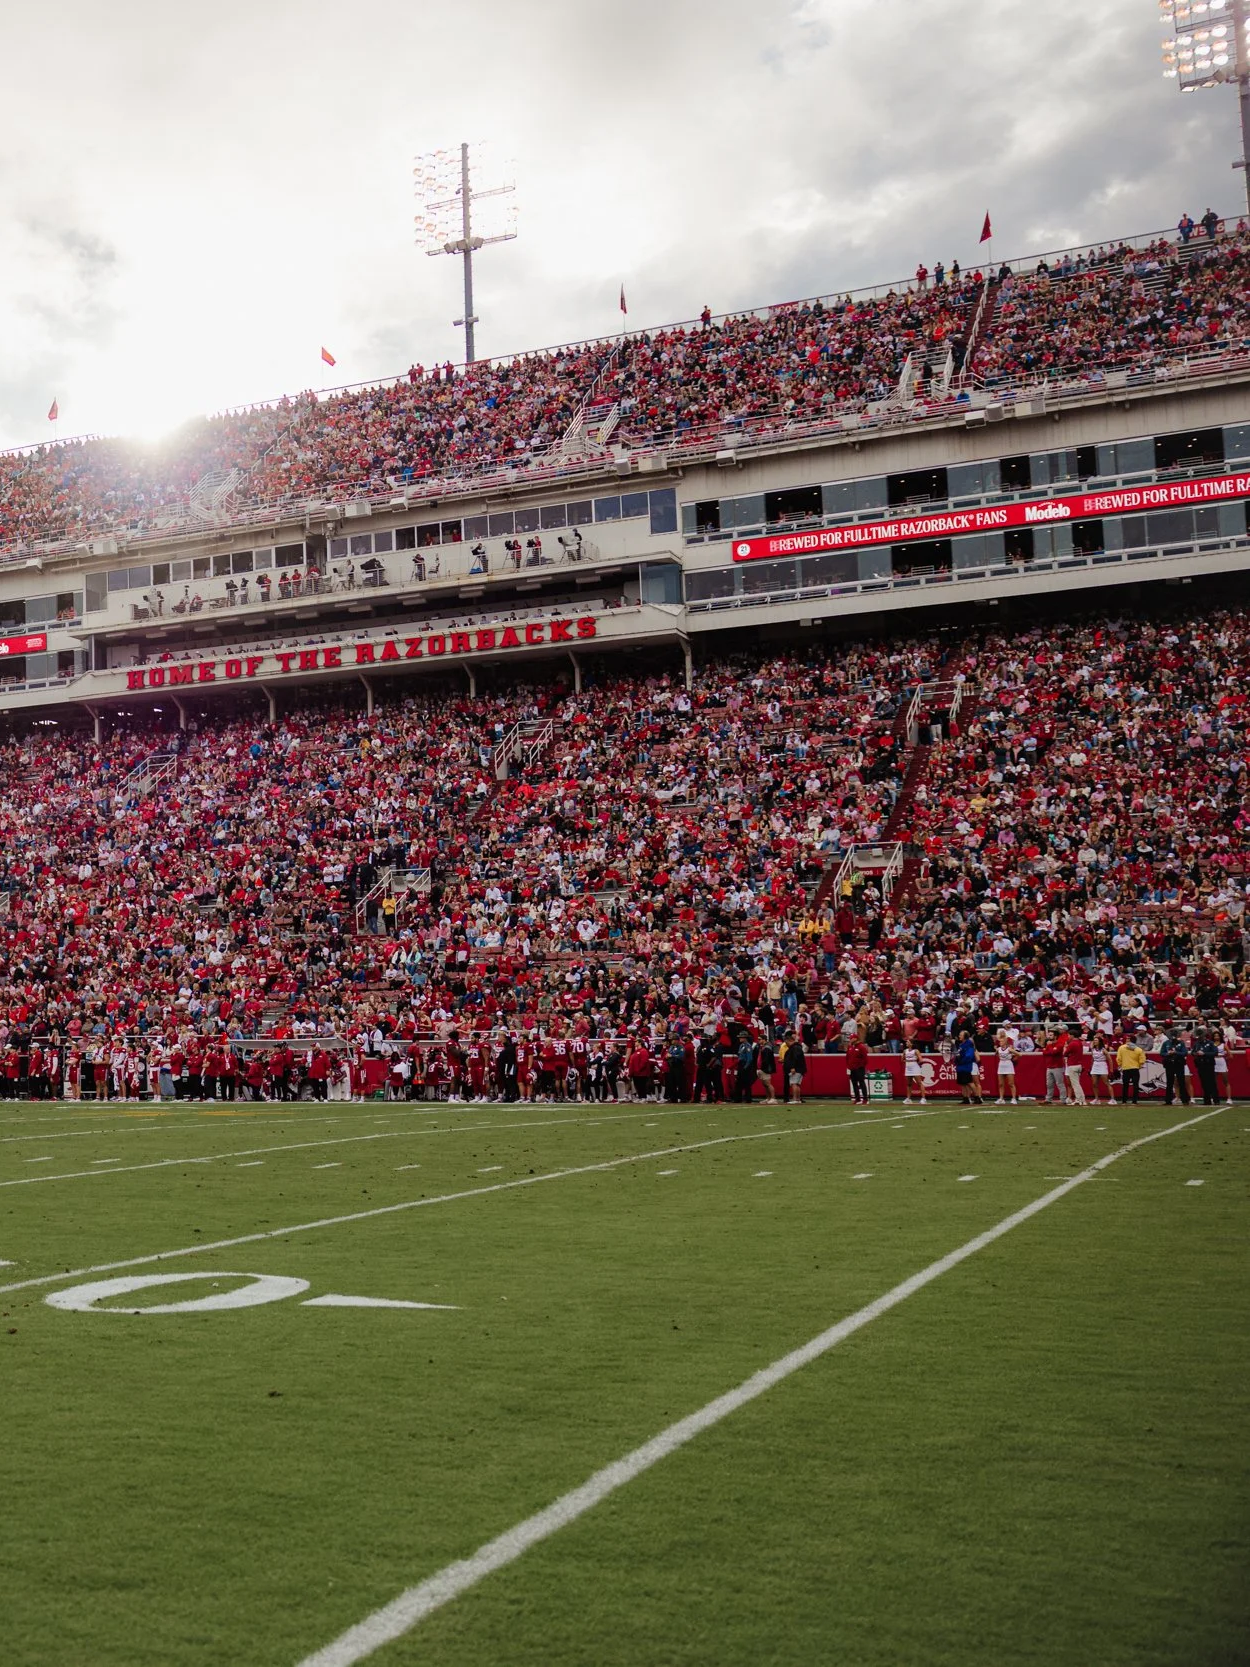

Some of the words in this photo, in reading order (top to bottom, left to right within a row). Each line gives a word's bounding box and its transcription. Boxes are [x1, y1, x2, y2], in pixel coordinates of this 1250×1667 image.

[1143, 489, 1169, 503] FOR
[1025, 503, 1070, 521] Modelo
[820, 532, 842, 546] FOR
[976, 510, 1007, 525] FANS
[126, 662, 216, 690] HOME
[225, 656, 263, 679] OF
[275, 646, 342, 673] THE
[355, 616, 597, 663] RAZORBACKS
